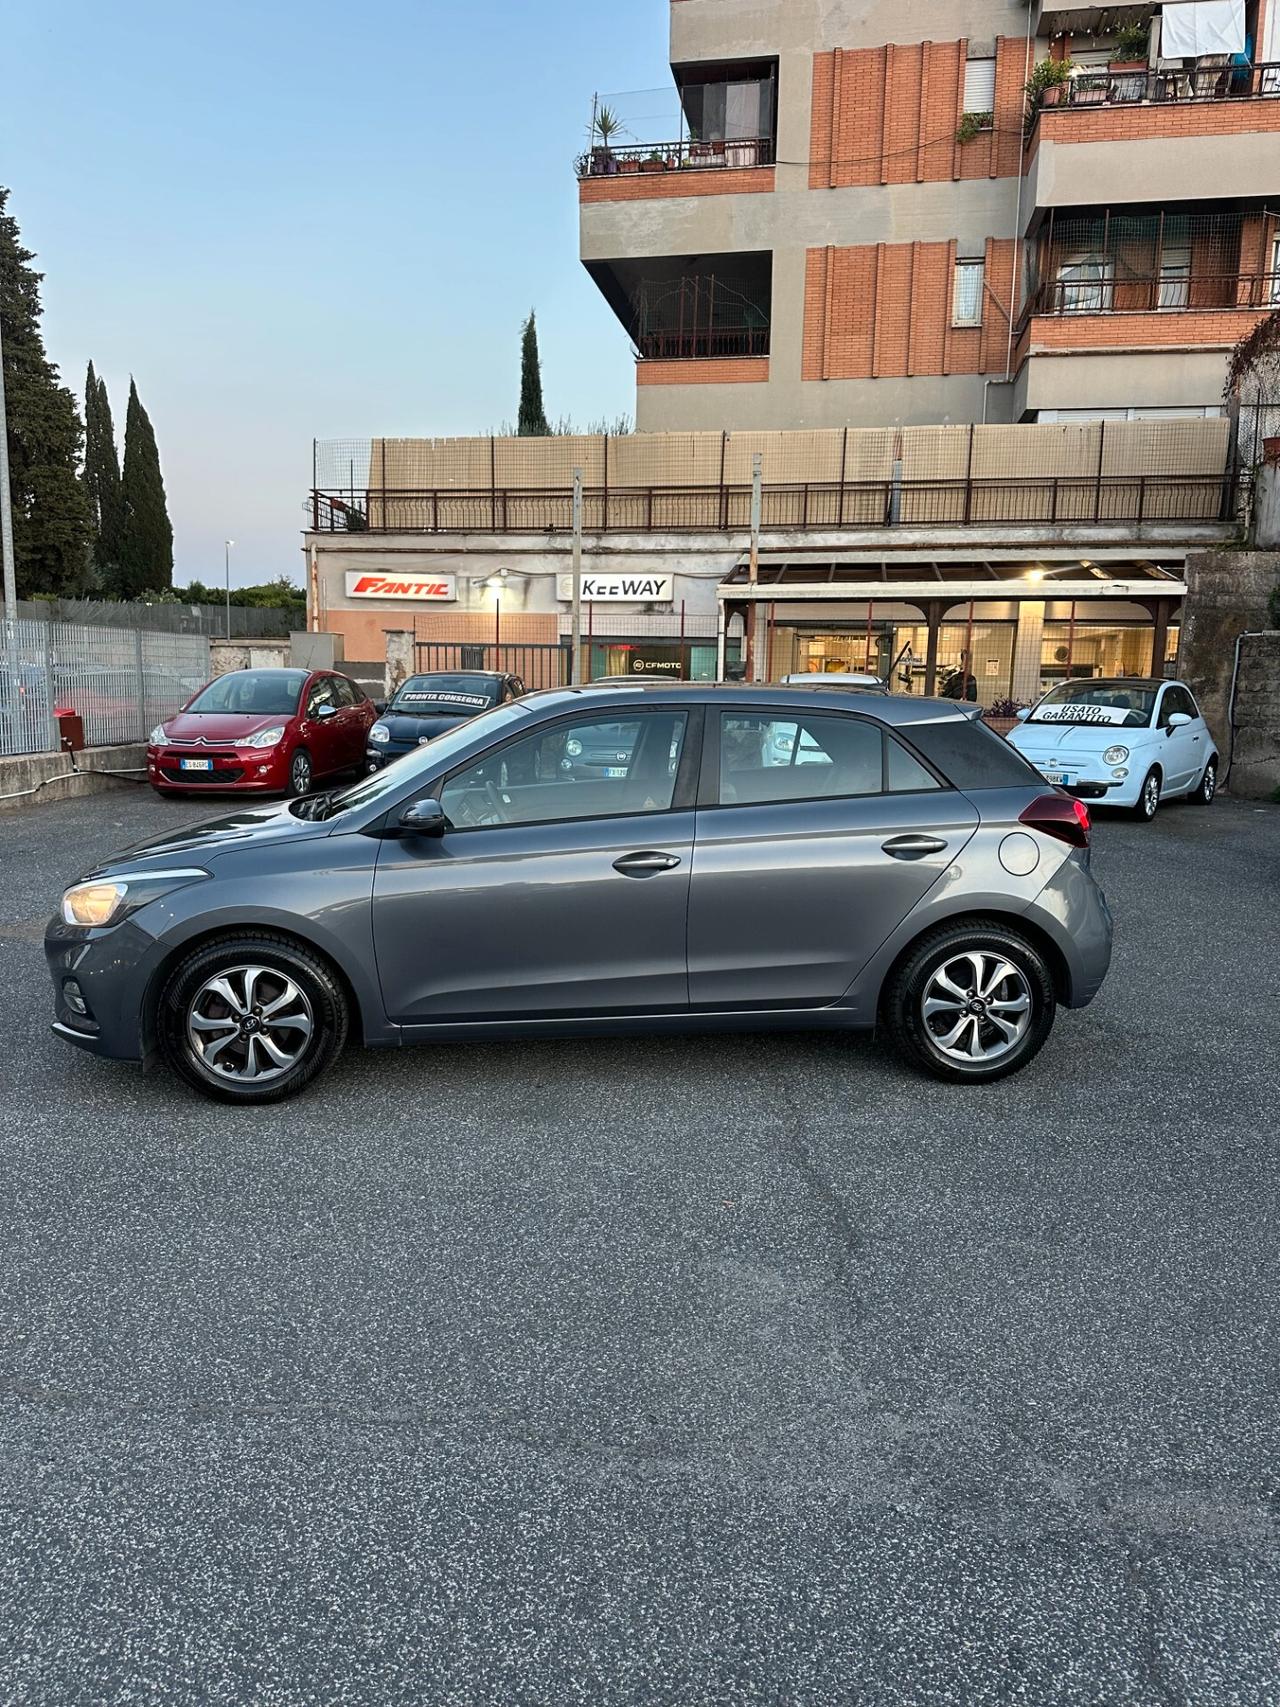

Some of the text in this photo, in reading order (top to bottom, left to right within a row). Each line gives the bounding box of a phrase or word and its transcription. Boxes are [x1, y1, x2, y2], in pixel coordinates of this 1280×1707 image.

[353, 577, 449, 595] FANTIC
[582, 580, 667, 595] KEEWAY
[438, 693, 484, 705] CONSEGNA
[1061, 705, 1102, 715] USATO
[1042, 711, 1112, 723] GARANTITO
